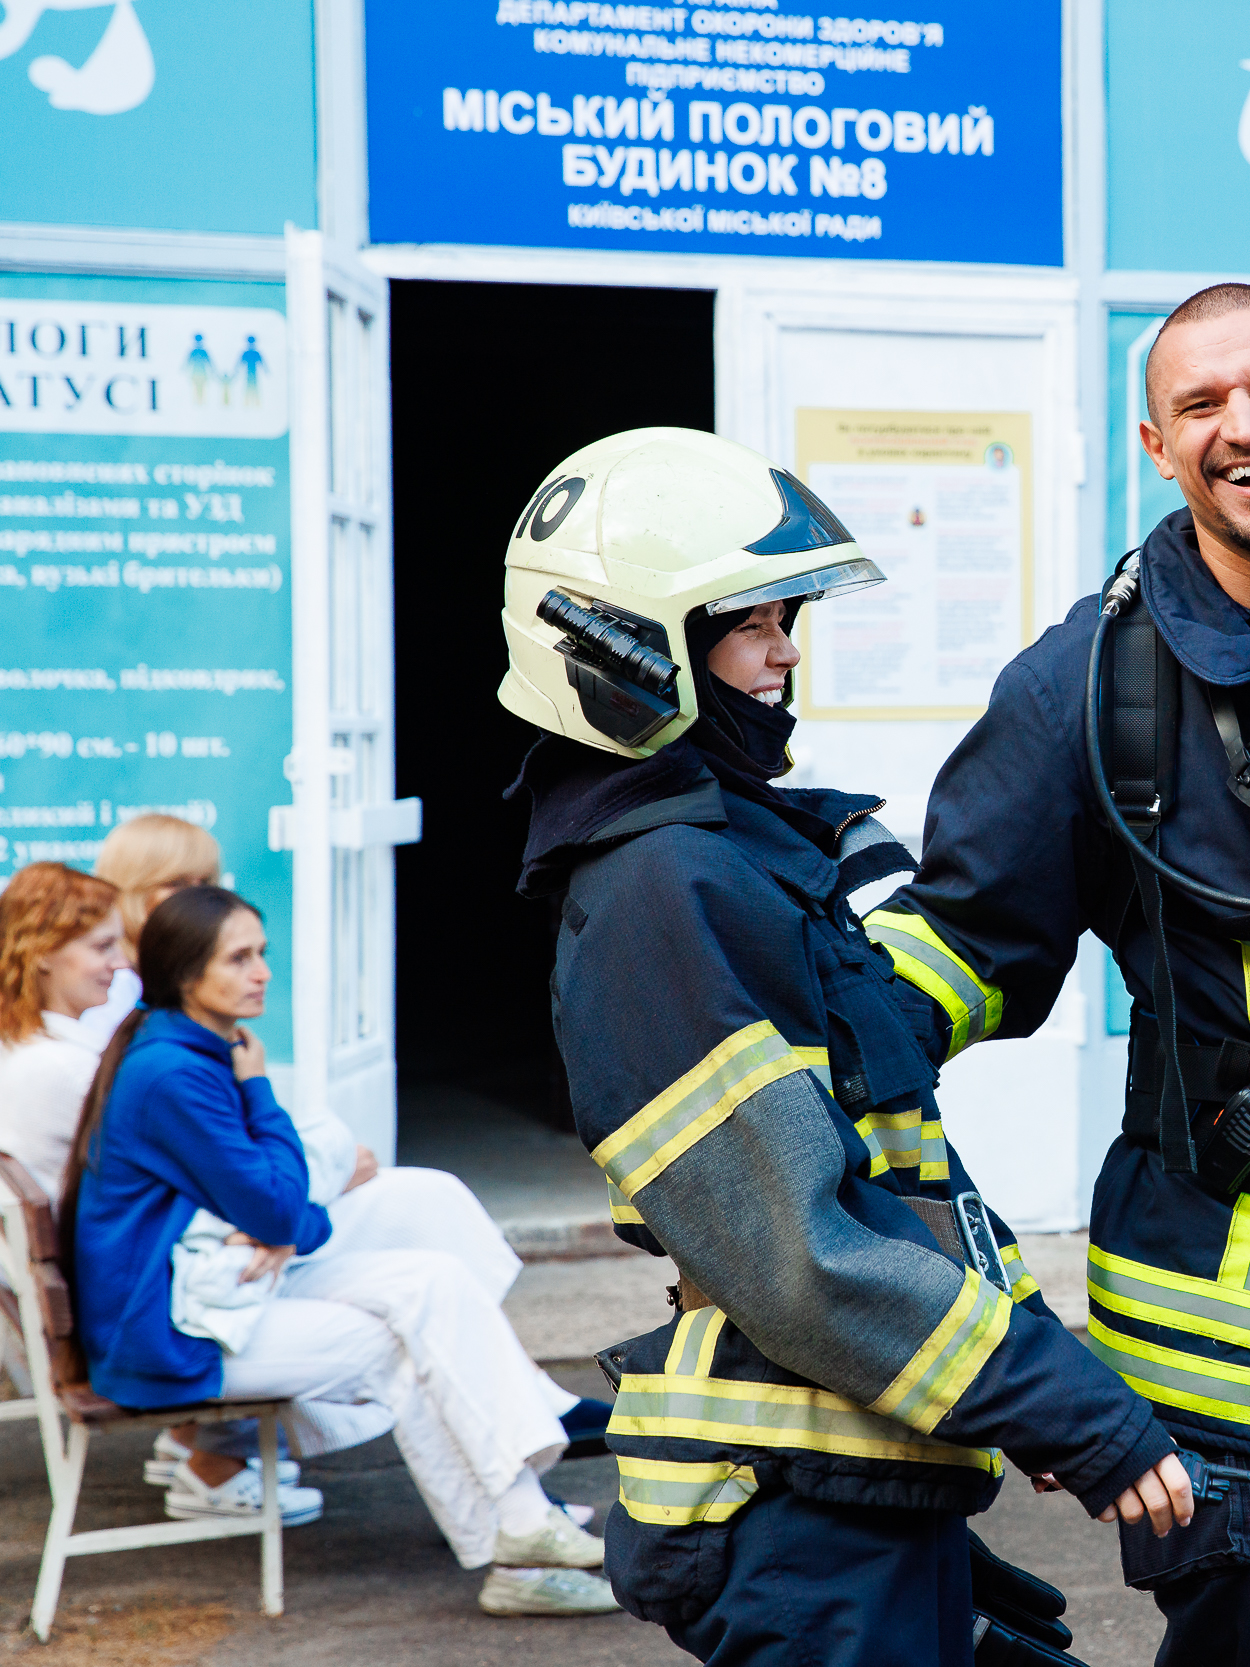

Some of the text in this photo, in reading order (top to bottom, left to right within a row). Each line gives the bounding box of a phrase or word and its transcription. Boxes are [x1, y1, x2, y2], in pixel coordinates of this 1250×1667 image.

[496, 0, 689, 32] ДЕПАРТАМЕНТ
[691, 8, 815, 40] ОХОРОНИ
[533, 28, 712, 62] КОМУНАЛЬНЕ
[442, 87, 996, 156] МІСЬКИЙ ПОЛОГОВИЙ
[562, 143, 888, 201] БУДИНОК №8
[567, 200, 883, 243] КИЇВСЬКОЇ МІСЬКОЇ РАДИ
[515, 474, 587, 542] 10
[145, 730, 178, 760] 10
